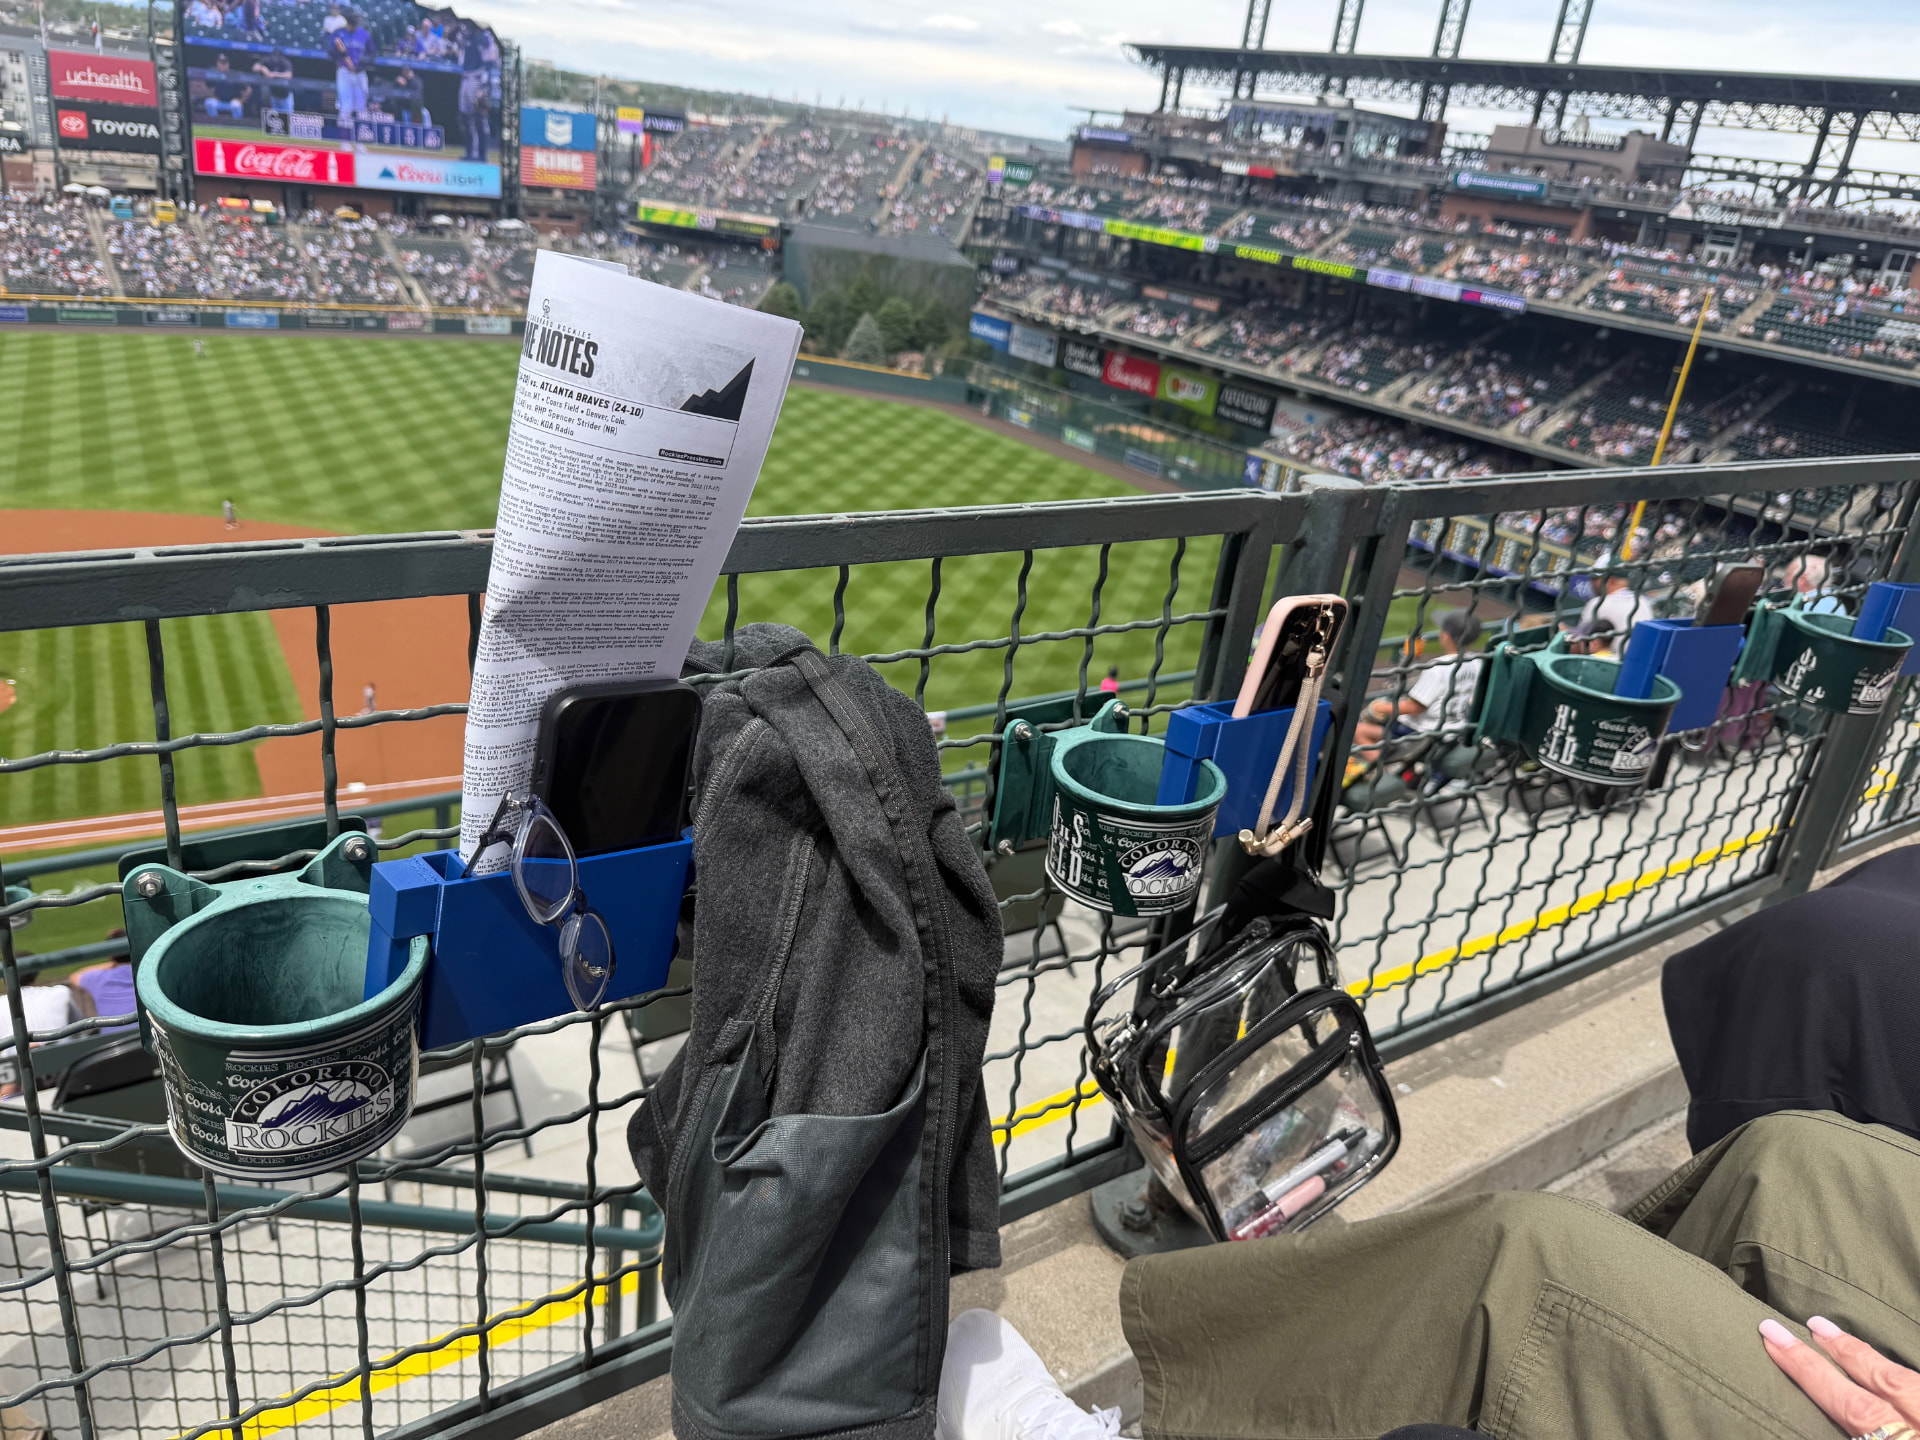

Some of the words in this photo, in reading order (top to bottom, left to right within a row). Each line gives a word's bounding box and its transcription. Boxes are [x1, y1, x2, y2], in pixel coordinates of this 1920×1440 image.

[66, 65, 143, 90] uchealth
[91, 119, 160, 139] TOYOTA
[534, 151, 583, 173] KING
[557, 324, 592, 340] ROCKIES
[536, 326, 598, 378] NOTES
[540, 381, 573, 399] ATLANTA
[575, 392, 610, 409] BRAVES
[611, 401, 644, 418] (24-10)
[534, 404, 547, 416] RHP
[548, 409, 575, 424] Spencer
[577, 418, 601, 430] Strider
[603, 423, 618, 436] (NR)
[545, 397, 563, 409] Coors
[564, 402, 579, 413] Field
[586, 409, 609, 421] Denver,
[611, 415, 627, 426] Colo.
[541, 419, 553, 430] KOA
[555, 422, 574, 436] Radio
[564, 447, 594, 459] homestand
[616, 460, 634, 468] season
[661, 467, 674, 475] third
[1119, 828, 1152, 838] ROCKIES
[1121, 839, 1200, 868] COLORADO
[225, 1062, 279, 1073] ROCKIES
[286, 1051, 340, 1070] ROCKIES
[182, 1080, 222, 1099] ROCKIES
[241, 1064, 383, 1116] COLORADO
[184, 1092, 226, 1116] Coors
[187, 1110, 225, 1130] ROCKIES
[233, 1088, 391, 1149] ROCKIES
[190, 1123, 226, 1146] Coors
[193, 1140, 230, 1160] ROCKIES
